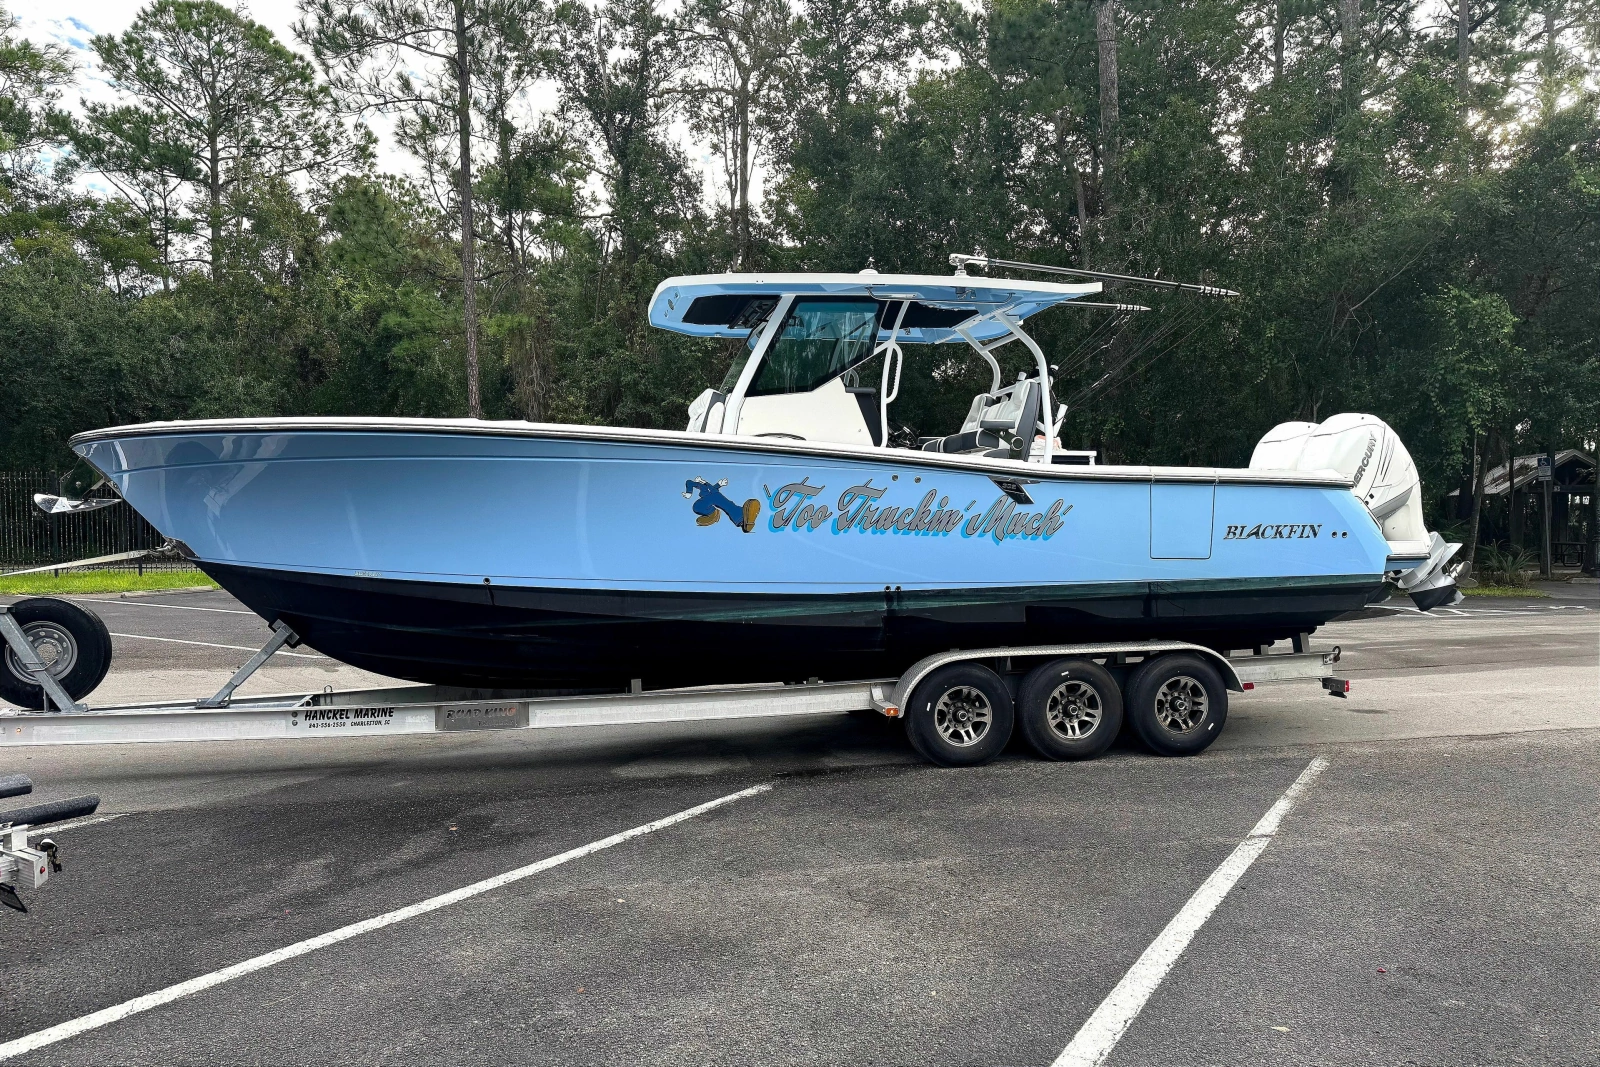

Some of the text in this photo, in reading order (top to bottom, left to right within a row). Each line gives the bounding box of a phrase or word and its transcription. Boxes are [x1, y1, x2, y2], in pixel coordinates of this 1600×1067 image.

[1223, 523, 1323, 540] BLACKFIN
[304, 709, 351, 721] HANCKEL
[353, 707, 395, 719] MARINE
